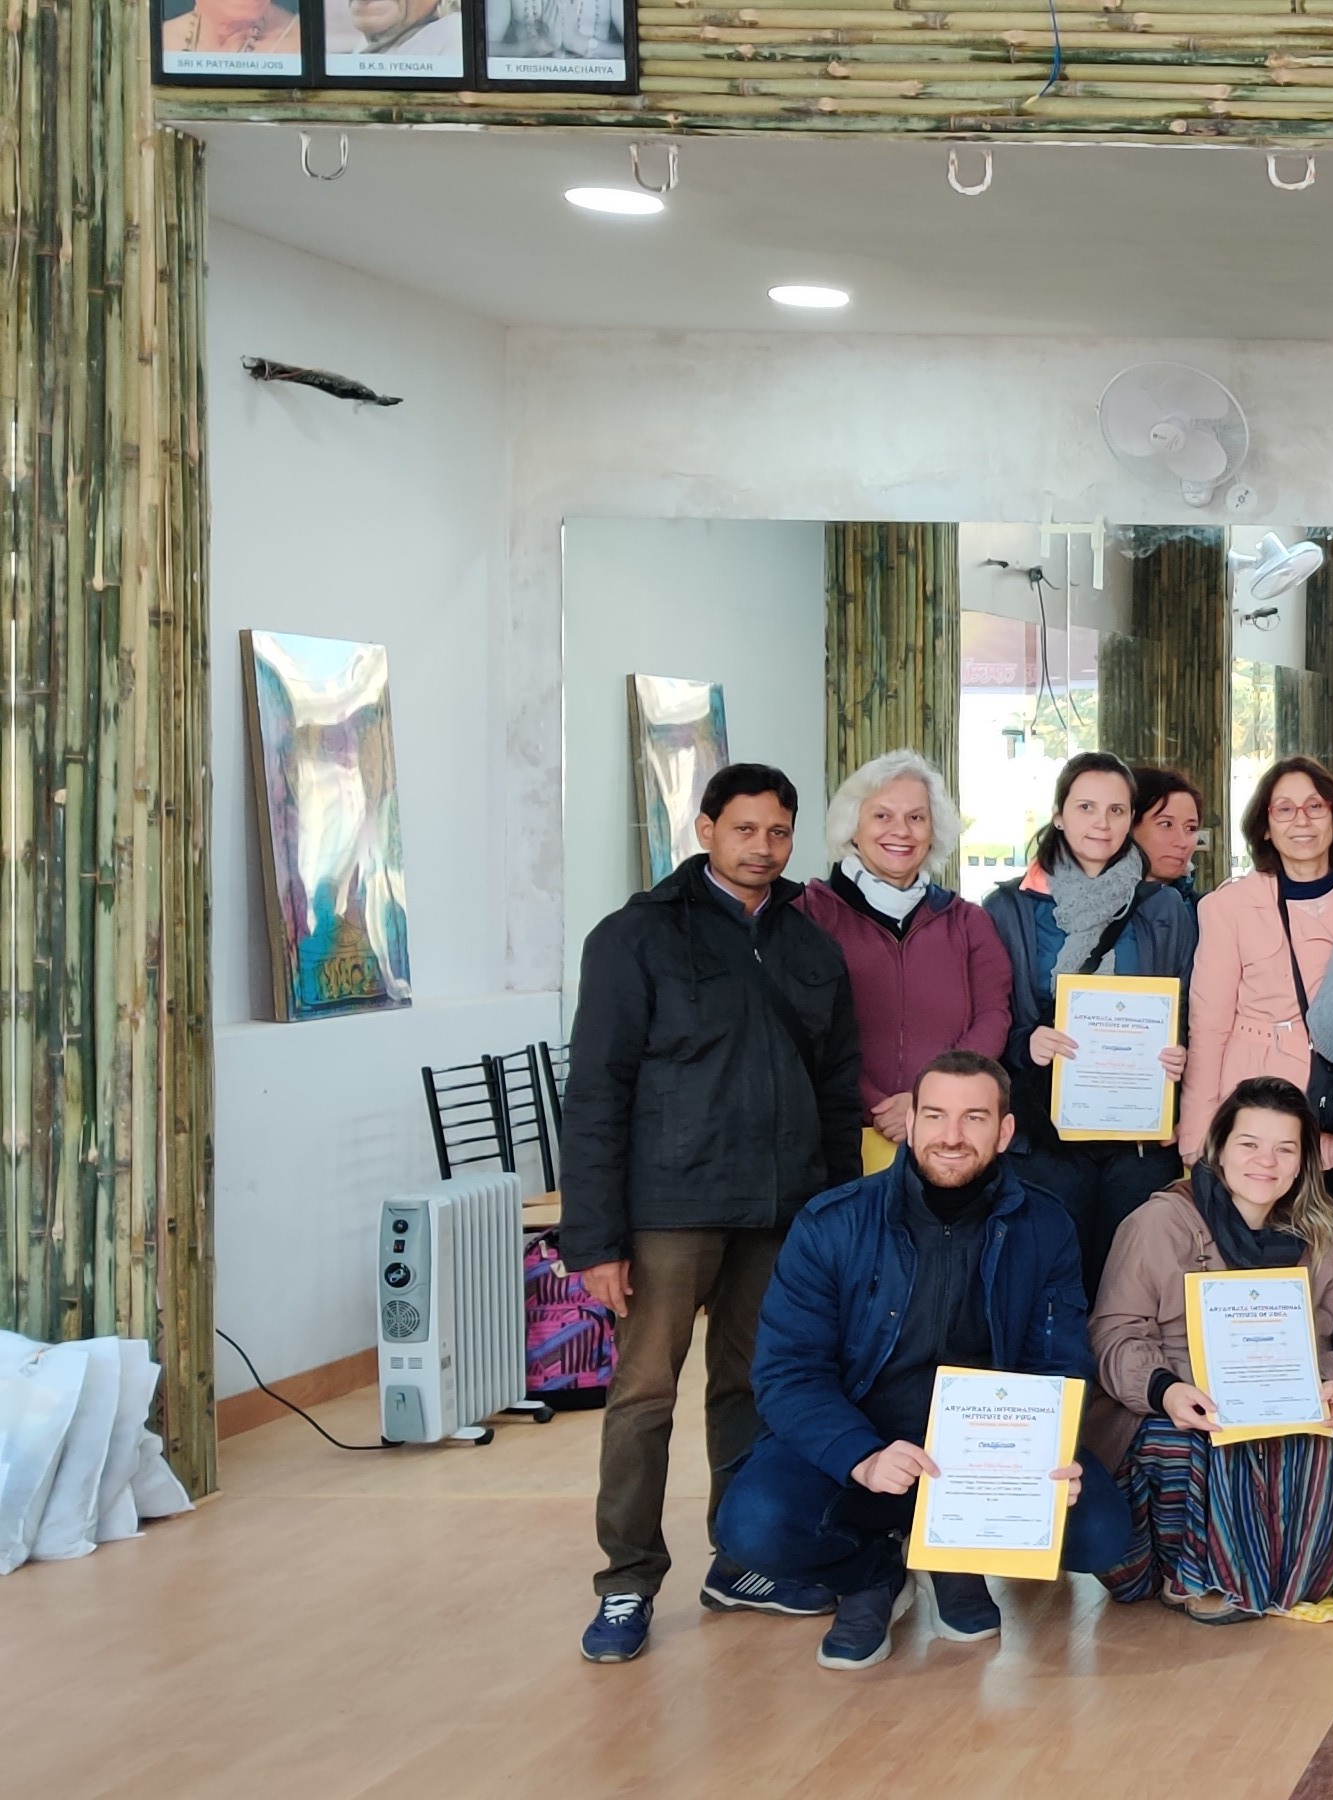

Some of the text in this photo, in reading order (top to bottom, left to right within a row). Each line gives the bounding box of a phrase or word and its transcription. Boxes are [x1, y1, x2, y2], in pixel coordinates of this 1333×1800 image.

[177, 59, 194, 68] SRI
[196, 60, 204, 68] K
[261, 61, 284, 70] JOIS
[389, 63, 433, 72] IYENGAR
[516, 65, 614, 76] KRISHNAMACHARYA
